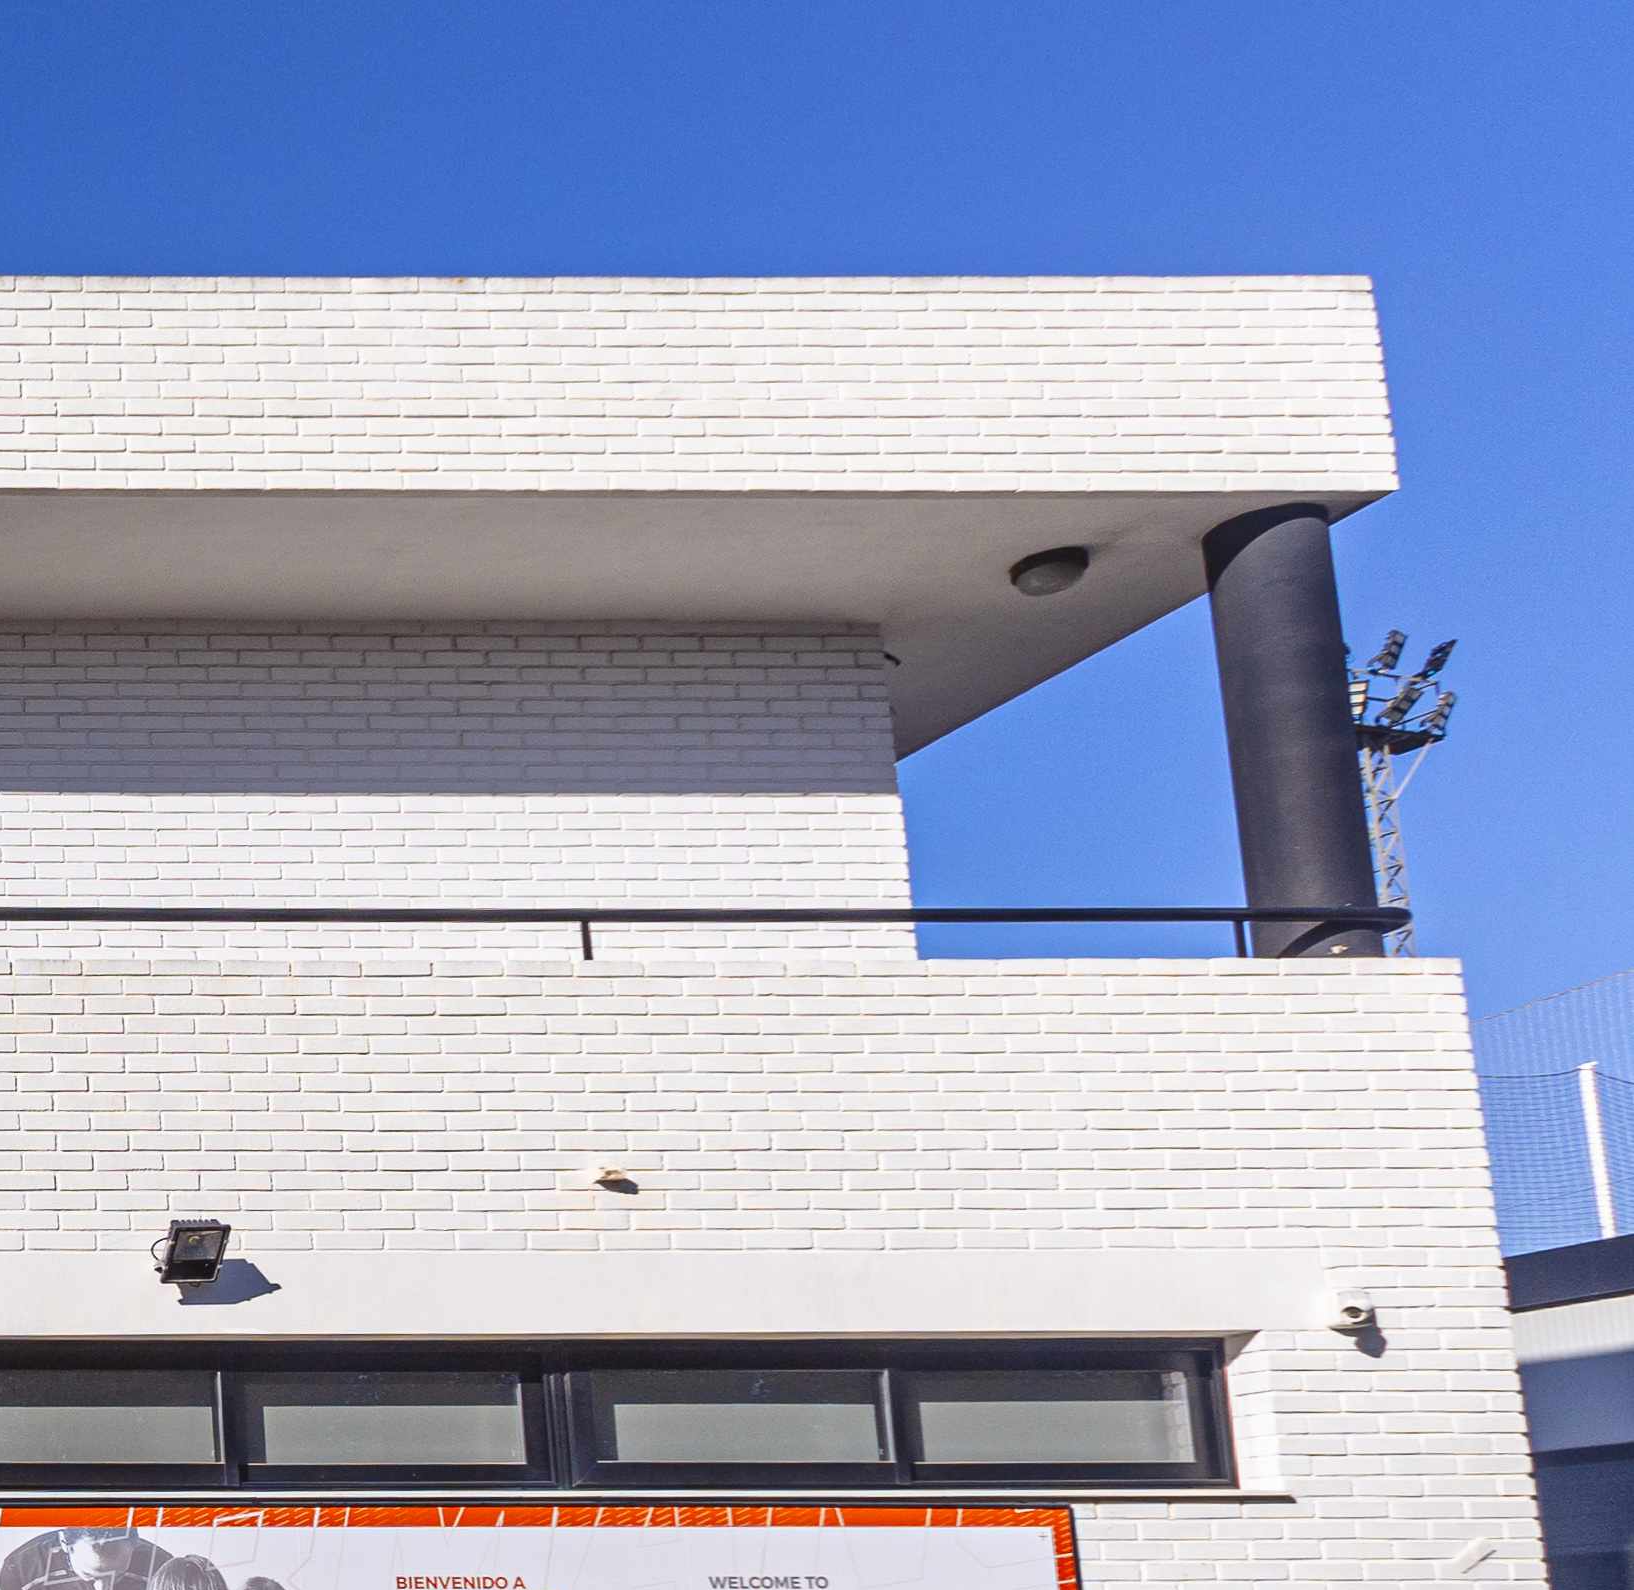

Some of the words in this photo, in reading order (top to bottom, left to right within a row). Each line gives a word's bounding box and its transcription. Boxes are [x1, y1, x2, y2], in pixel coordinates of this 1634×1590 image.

[396, 1576, 509, 1590] BIENVENIDO
[512, 1576, 527, 1590] A
[708, 1576, 802, 1590] WELCOME
[803, 1576, 829, 1590] TO
